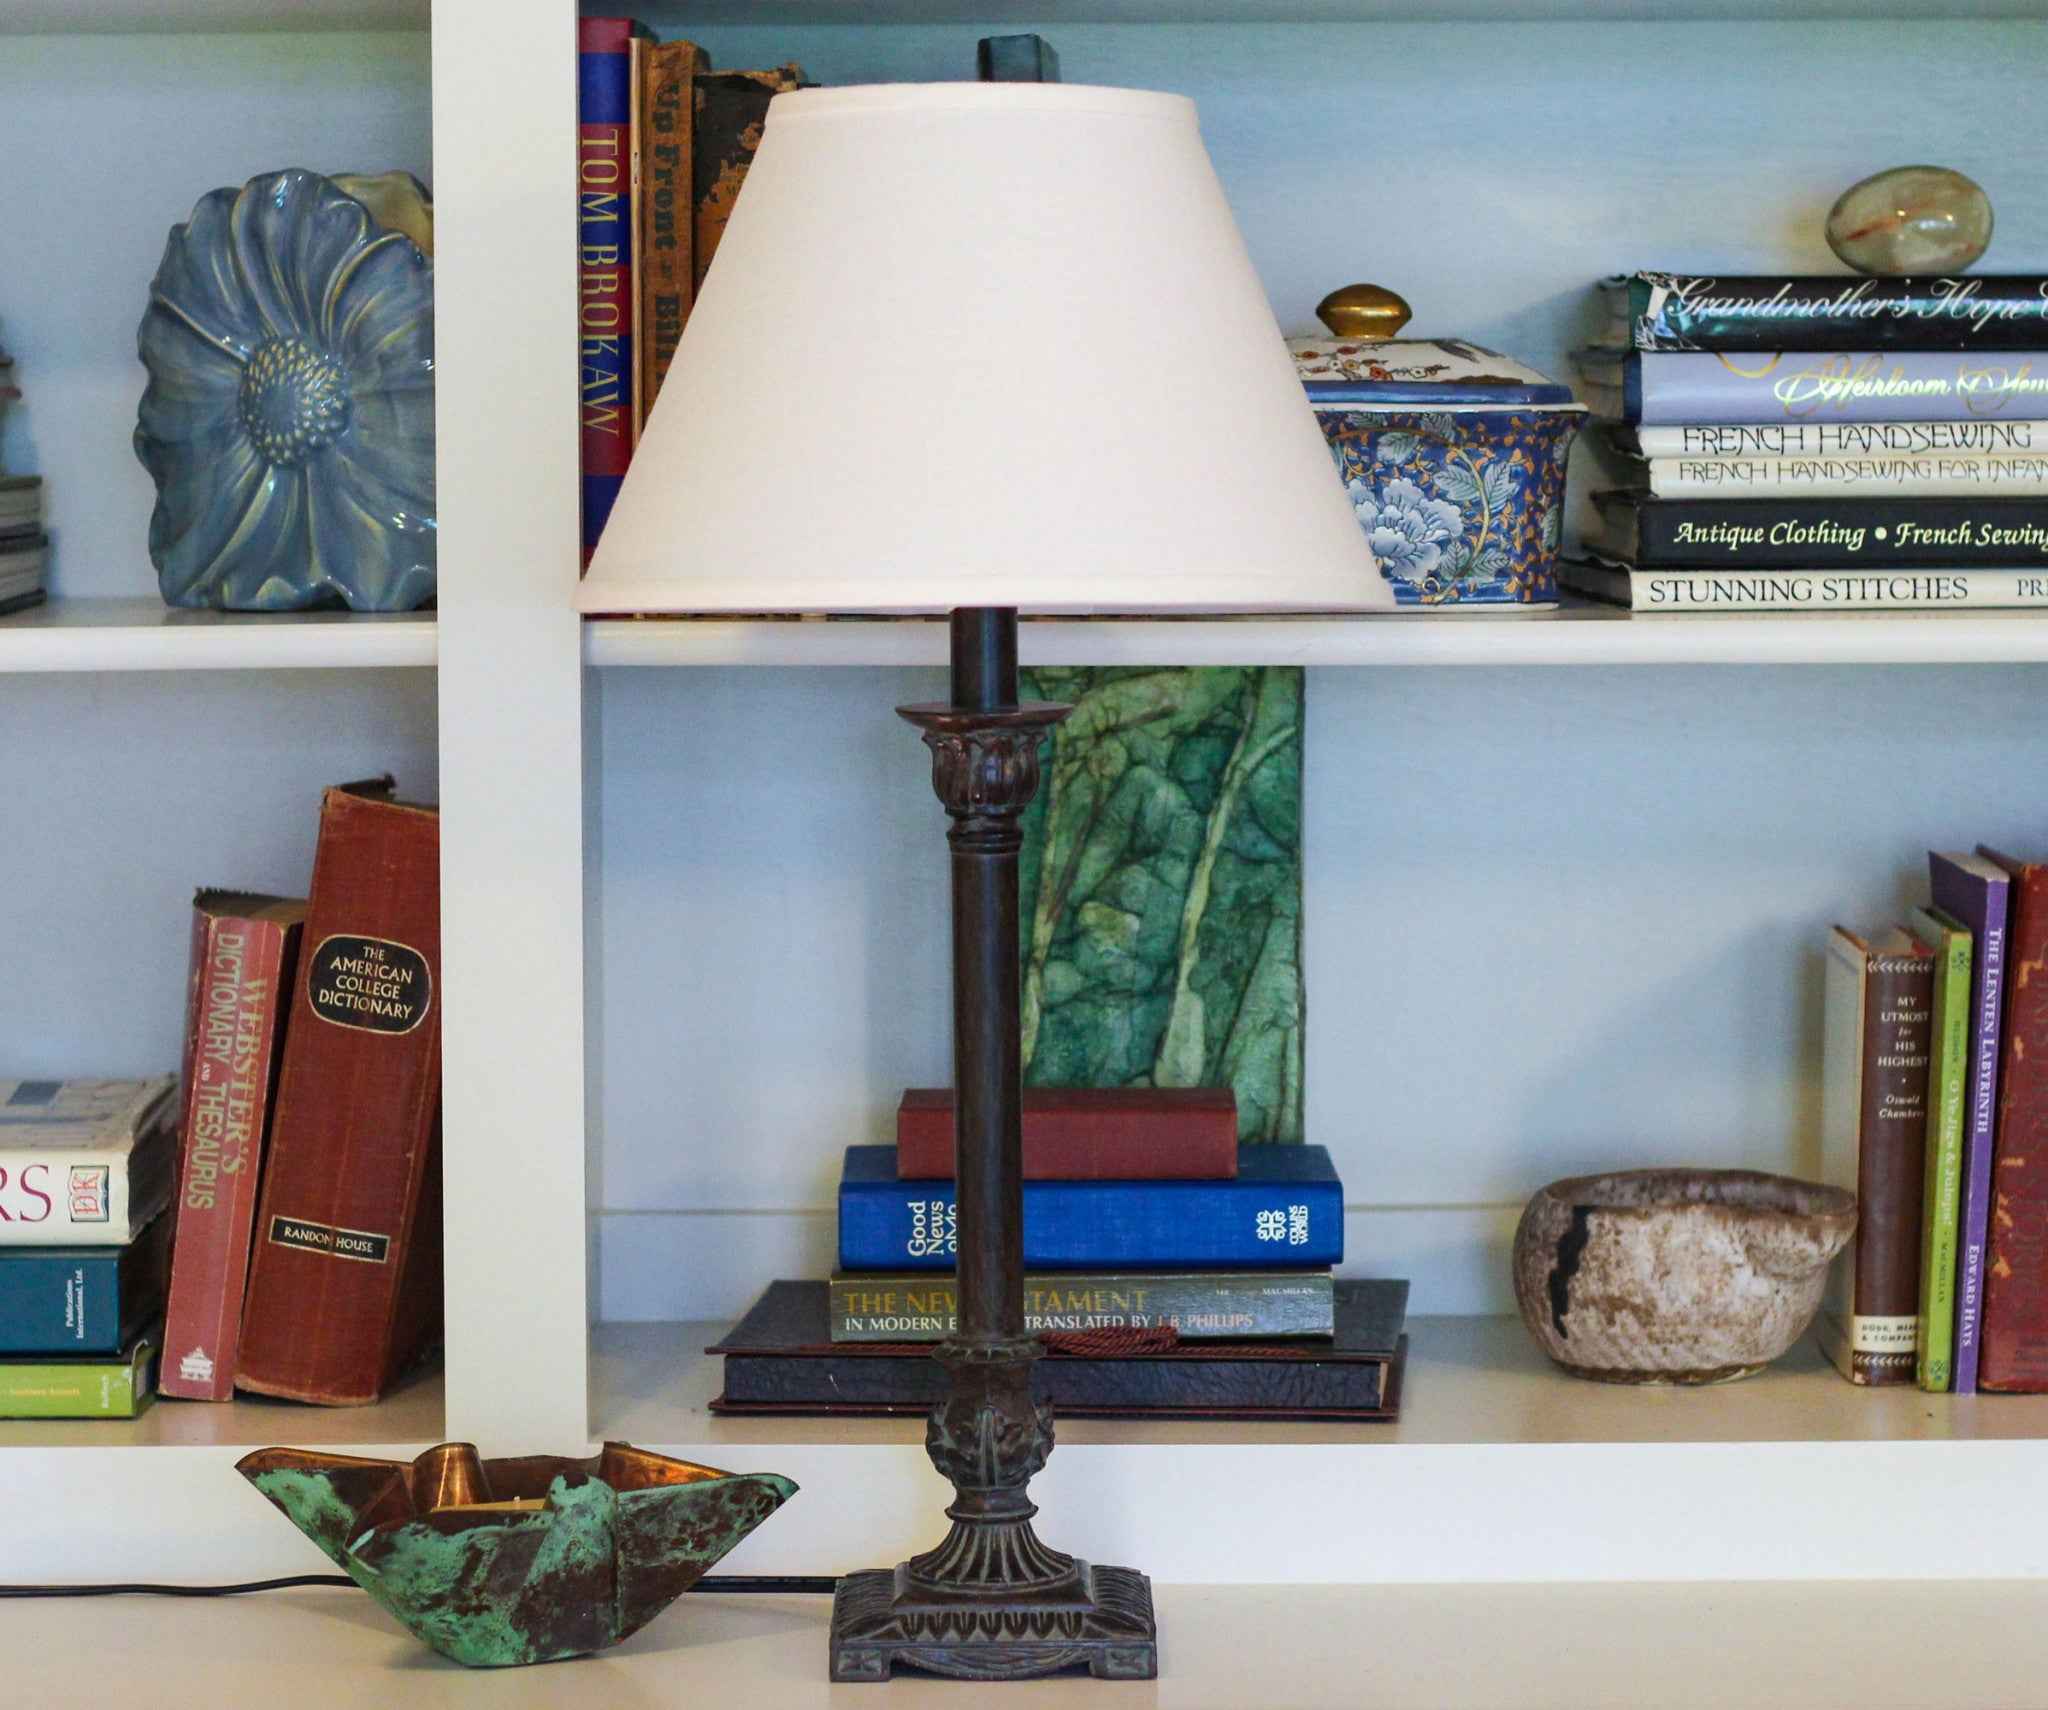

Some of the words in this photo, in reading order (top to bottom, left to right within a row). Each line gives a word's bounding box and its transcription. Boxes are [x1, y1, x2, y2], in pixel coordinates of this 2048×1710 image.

[581, 128, 619, 224] TOM
[655, 144, 680, 250] Front
[1667, 278, 1912, 322] Grandmother's
[1917, 278, 2033, 332] Hope
[581, 244, 620, 435] BROKAW
[1683, 427, 1804, 456] FRENCH
[1819, 423, 2031, 454] HANDSEWING
[1679, 461, 1767, 484] FRENCH
[1777, 459, 1931, 483] HANDSEWING
[1938, 459, 1980, 482] FOR
[1673, 521, 1764, 550] Antique
[1769, 519, 1866, 550] Clothing
[1894, 520, 1971, 548] French
[1649, 579, 1813, 603] STUNNING
[1822, 577, 1969, 601] STITCHES
[2017, 578, 2048, 597] PR
[362, 946, 385, 961] THE
[1987, 927, 2002, 963] THE
[330, 955, 413, 984] AMERICAN
[204, 932, 245, 1064] DICTIONARY
[319, 988, 413, 1019] DICTIONARY
[336, 975, 401, 1000] COLLEGE
[1897, 996, 1917, 1007] MY
[1983, 968, 2000, 1033] LENTEN
[1881, 1011, 1929, 1023] UTMOST
[1877, 1056, 1928, 1068] HIGHEST
[1895, 1041, 1916, 1052] HIS
[222, 978, 267, 1176] WEBSTER'S
[1977, 1038, 1996, 1133] LABYRINTH
[187, 1083, 228, 1210] THESAURUS
[907, 1200, 927, 1257] Good
[926, 1200, 945, 1256] News
[335, 1236, 374, 1253] HOUSE
[1966, 1244, 1980, 1305] EDWARD
[842, 1291, 897, 1314] THE
[844, 1316, 864, 1331] IN
[868, 1316, 943, 1332] MODERN
[1024, 1315, 1125, 1330] TRANSLATED
[1131, 1315, 1152, 1329] BY
[1187, 1313, 1254, 1329] PHILLIPS
[1961, 1307, 1976, 1347] HAYS
